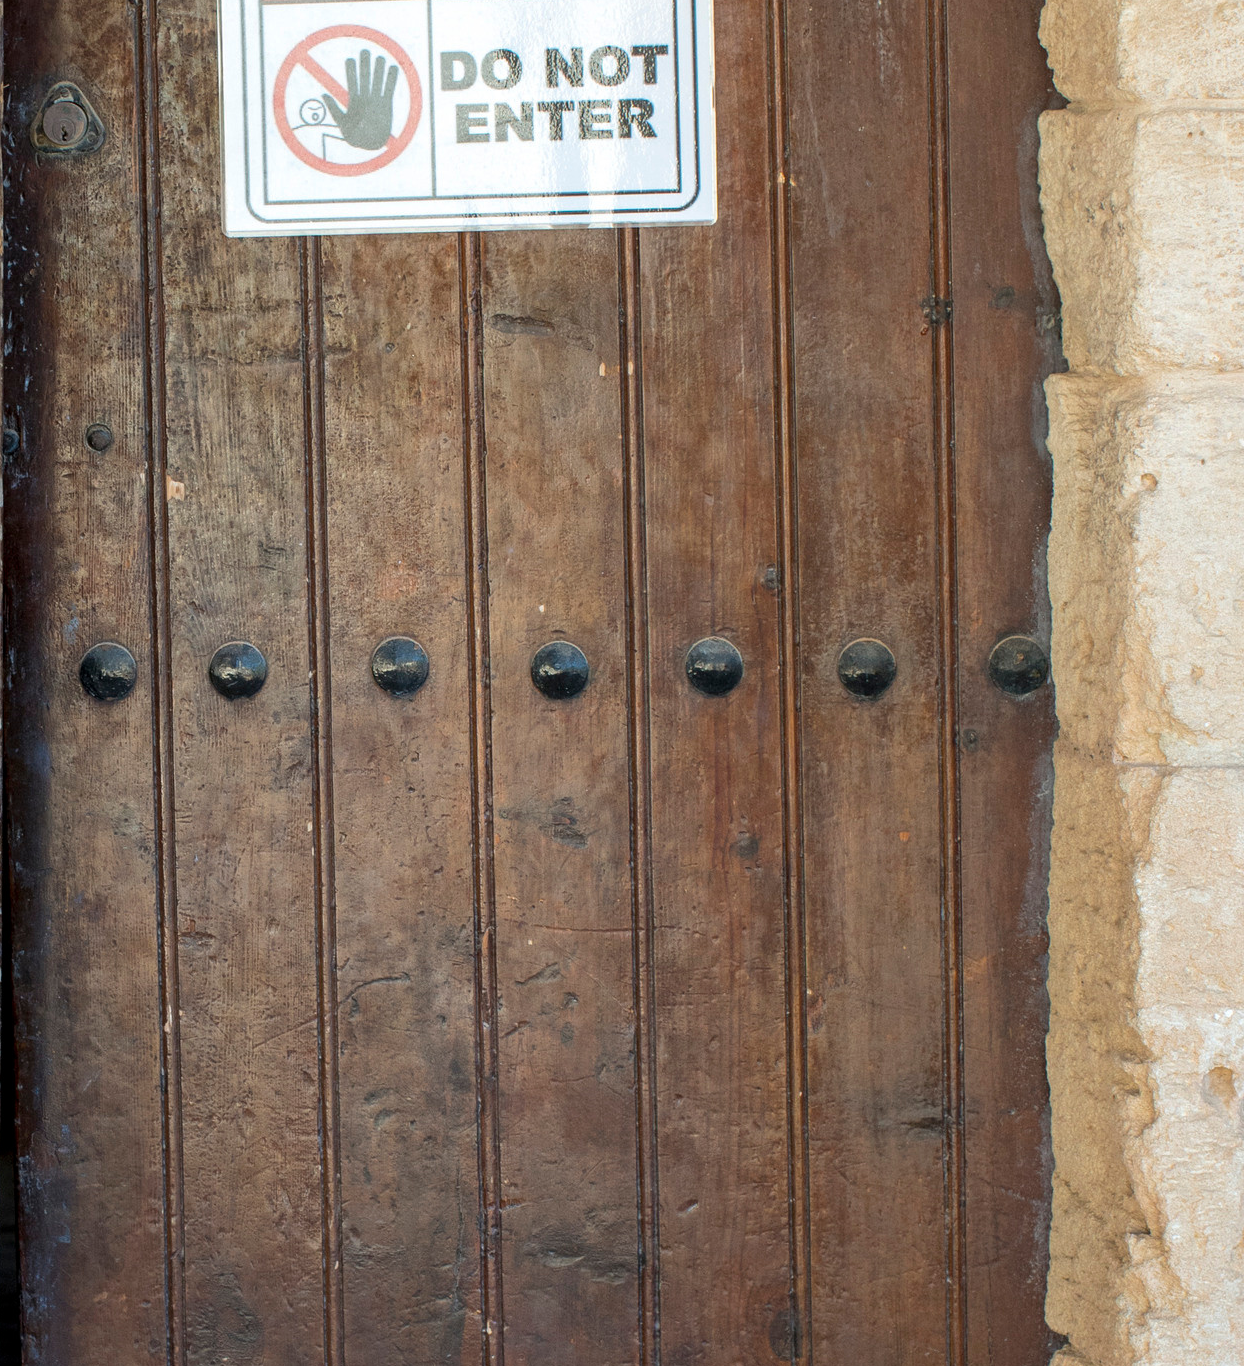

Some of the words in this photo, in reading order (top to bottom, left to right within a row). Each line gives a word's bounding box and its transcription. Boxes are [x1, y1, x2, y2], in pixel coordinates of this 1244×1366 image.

[440, 49, 523, 91] DO
[545, 44, 668, 88] NOT
[455, 98, 658, 144] ENTER
